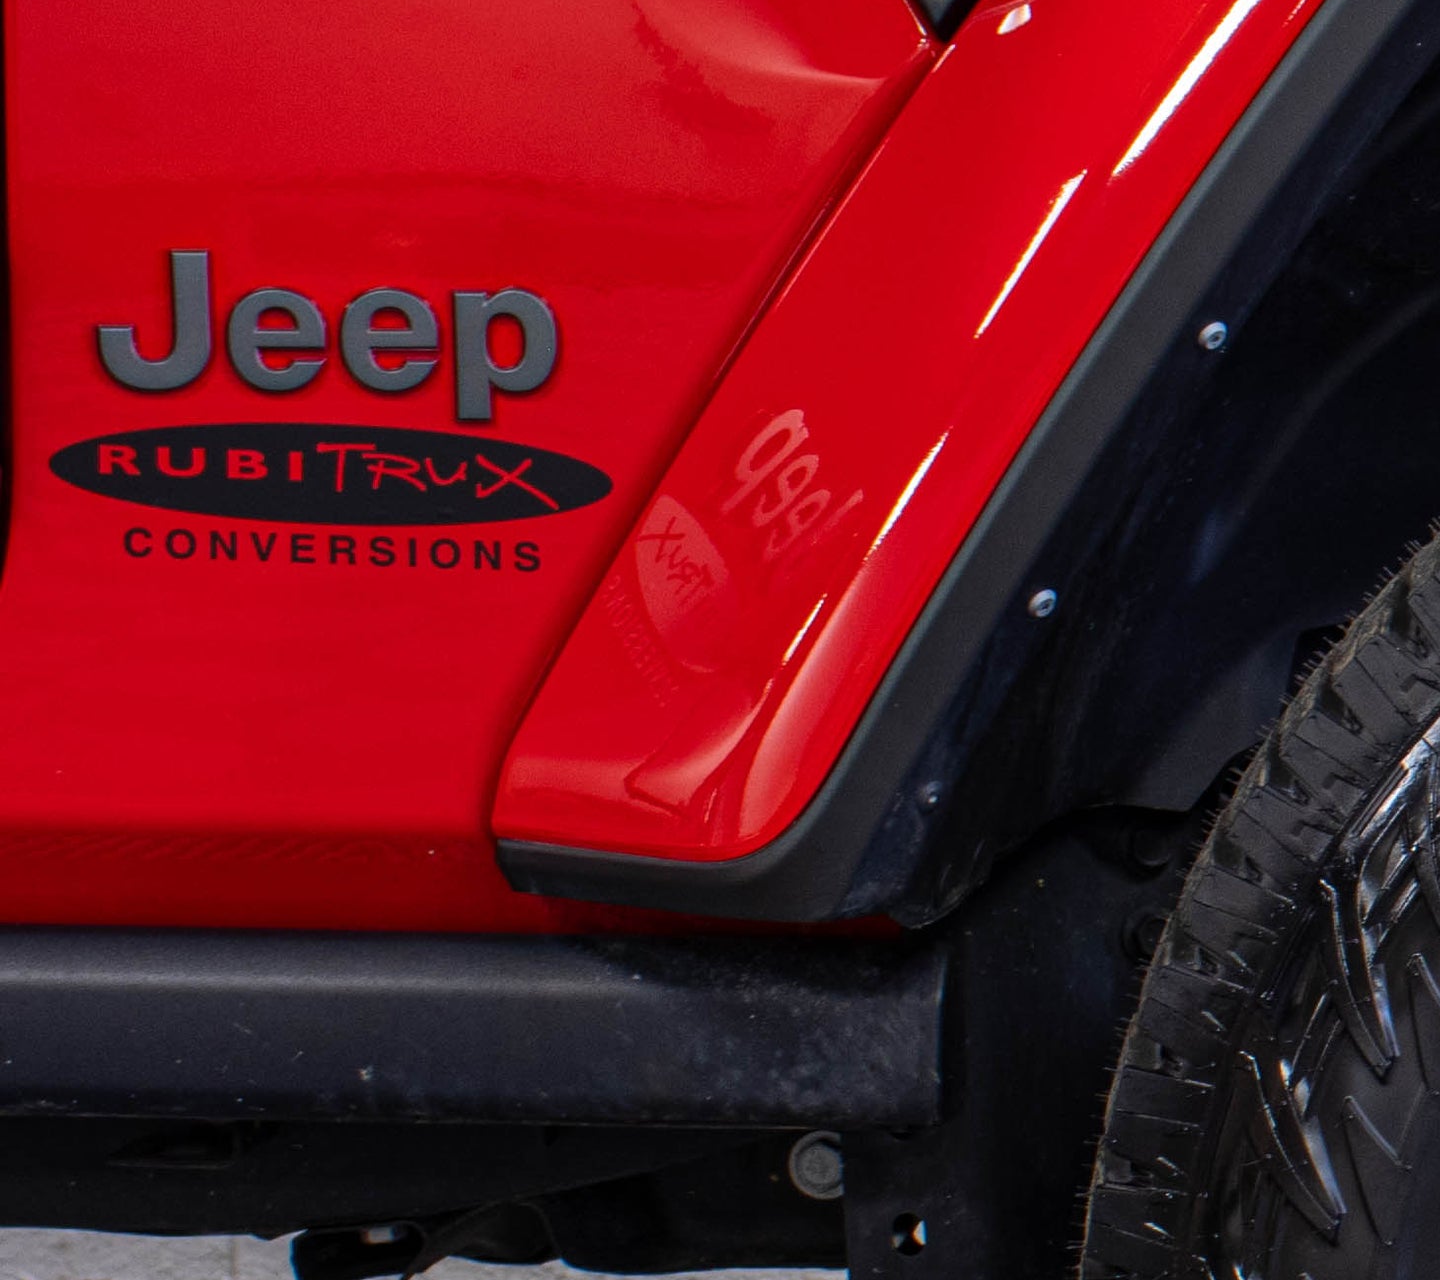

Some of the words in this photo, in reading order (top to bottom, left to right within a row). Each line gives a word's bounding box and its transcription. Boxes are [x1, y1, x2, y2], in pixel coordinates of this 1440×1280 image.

[99, 249, 558, 421] Jeep
[96, 441, 560, 510] RUBITRUX
[123, 526, 542, 573] CONVERSIONS
